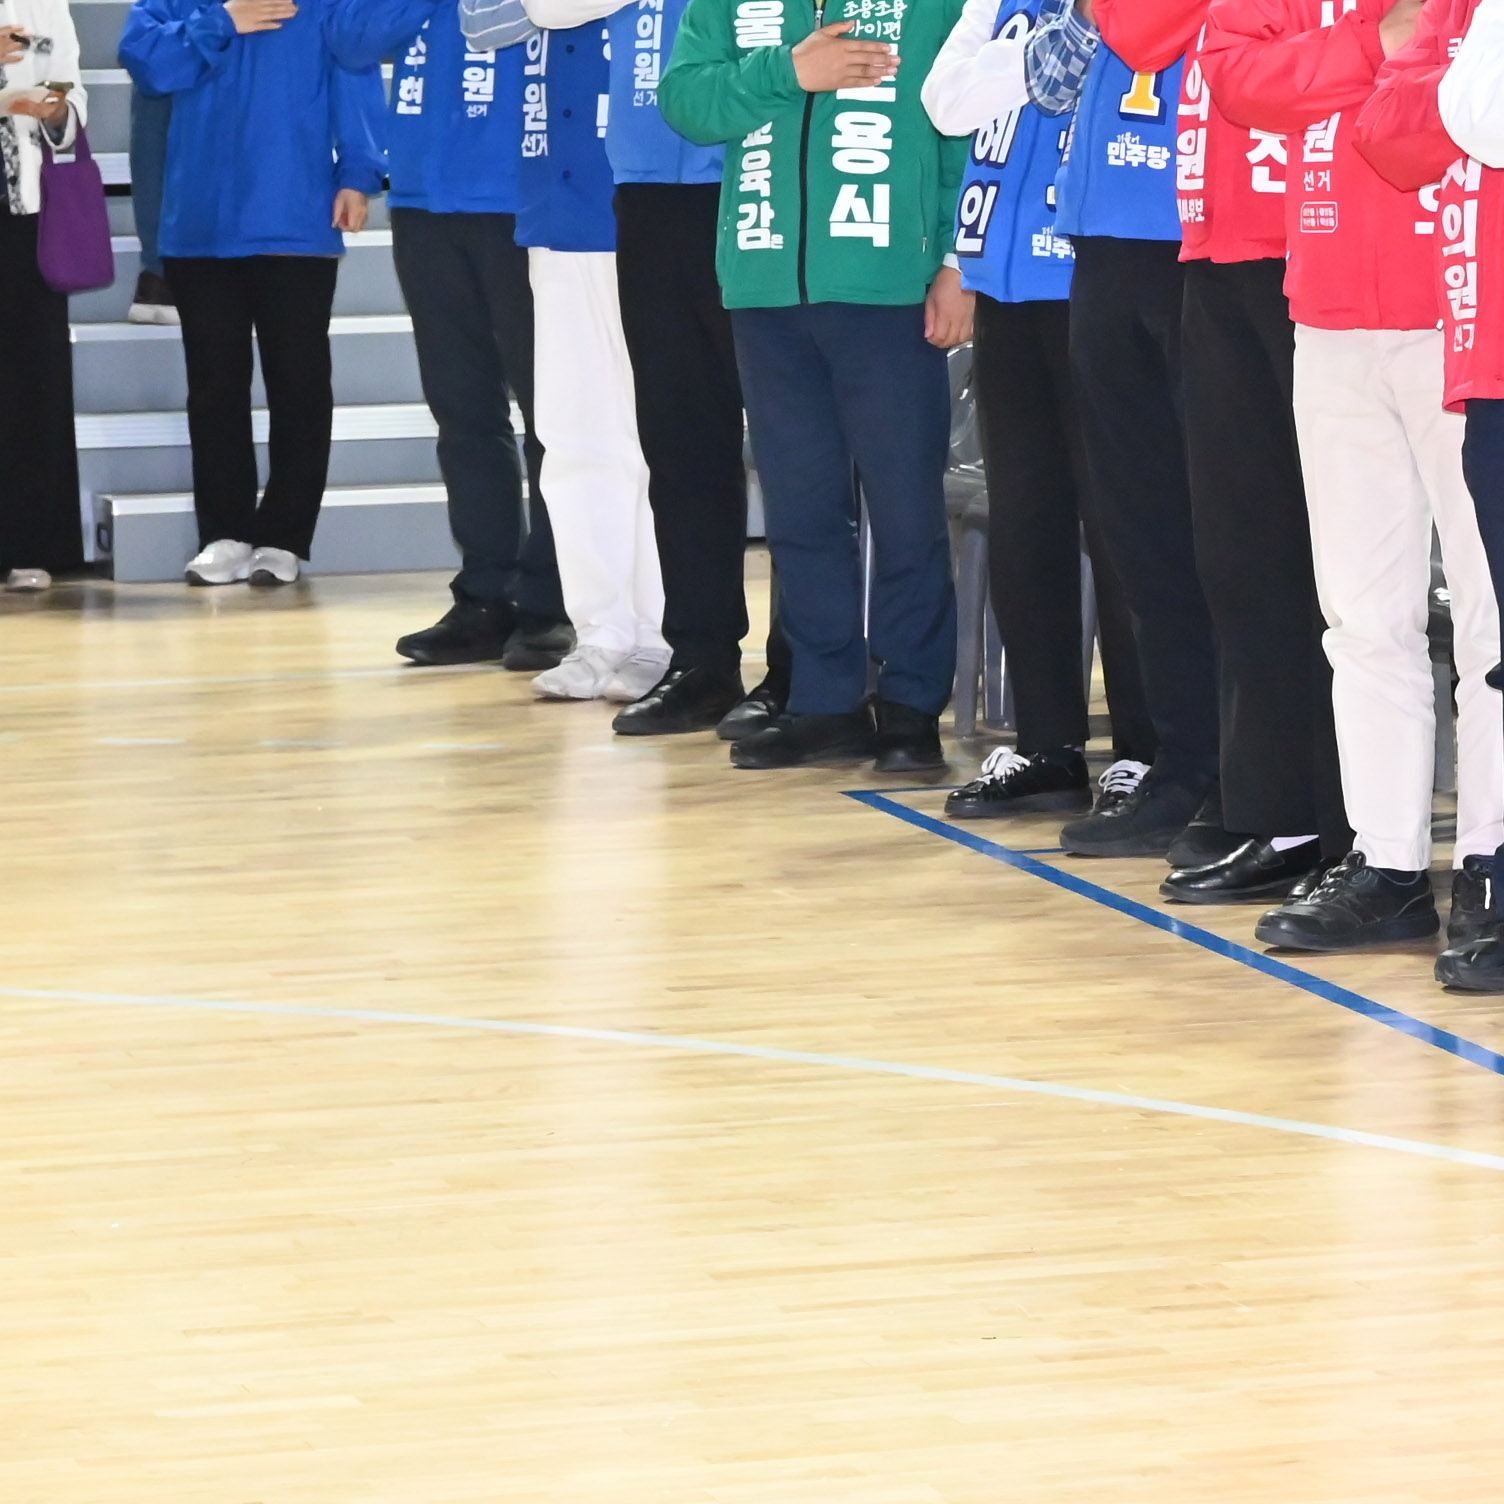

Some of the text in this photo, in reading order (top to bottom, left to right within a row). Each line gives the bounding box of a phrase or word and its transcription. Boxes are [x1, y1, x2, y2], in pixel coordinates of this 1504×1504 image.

[633, 90, 657, 106] 선거
[466, 104, 488, 119] 선거
[521, 133, 549, 158] 선거
[1107, 142, 1171, 170] 민주당
[1303, 169, 1332, 192] 선거
